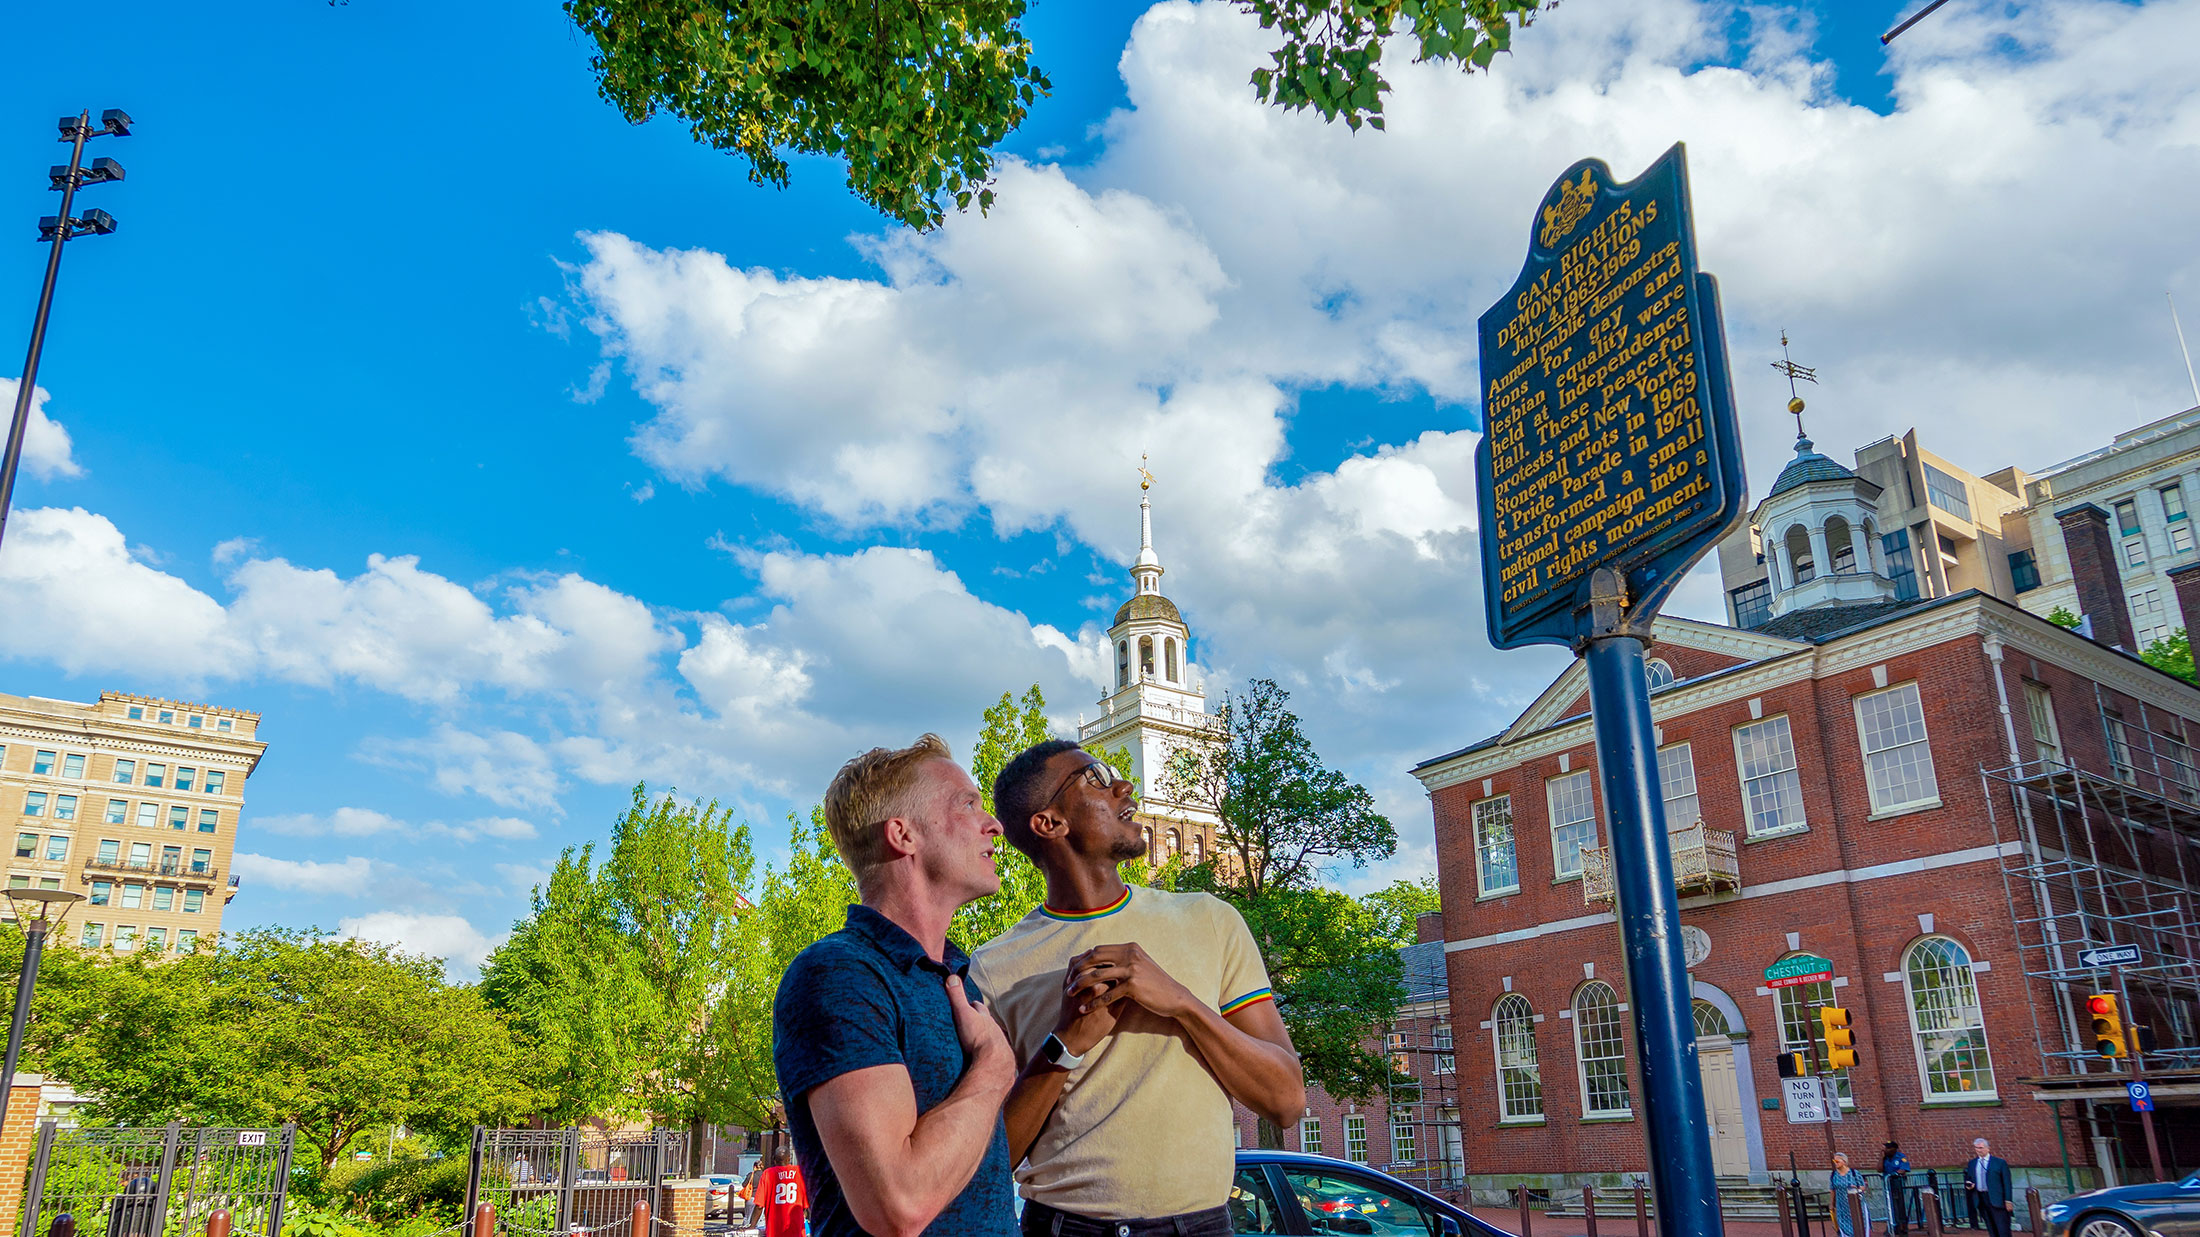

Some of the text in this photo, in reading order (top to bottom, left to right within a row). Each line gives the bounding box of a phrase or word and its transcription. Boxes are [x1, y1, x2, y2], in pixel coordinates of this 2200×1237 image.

[1488, 241, 1680, 399] Annual public demonstra-
[1497, 200, 1658, 349] DEMONSTRATIONS
[1512, 322, 1544, 357] July
[1563, 238, 1641, 314] 1965-1969
[1517, 200, 1632, 310] GAY RIGHTS
[1488, 255, 1682, 417] tions for gay and
[1490, 284, 1685, 439] lesbian equality were
[1491, 306, 1687, 458] held at Independence
[1492, 323, 1691, 479] Hall. These peaceful
[1494, 352, 1694, 501] protests and New York's
[1494, 371, 1697, 518] Stonewall riots in 1969
[1498, 397, 1701, 539] & Pride Parade in 1970,
[1500, 418, 1704, 560] transformed a small
[1501, 449, 1708, 582] national campaign into a
[1504, 473, 1711, 603] civil rights movement.
[1510, 588, 1549, 614] PENNSYLVANIA
[1551, 568, 1585, 590] HISTORICAL
[1587, 559, 1600, 570] AND
[1602, 543, 1628, 561] MUSEUM
[1628, 518, 1672, 547] COMMISSION
[1767, 963, 1827, 979] CHESTNUT ST
[2096, 950, 2133, 961] ONE WAY
[242, 1134, 263, 1143] EXIT
[1792, 1082, 1810, 1090] NO
[775, 1182, 797, 1204] 26
